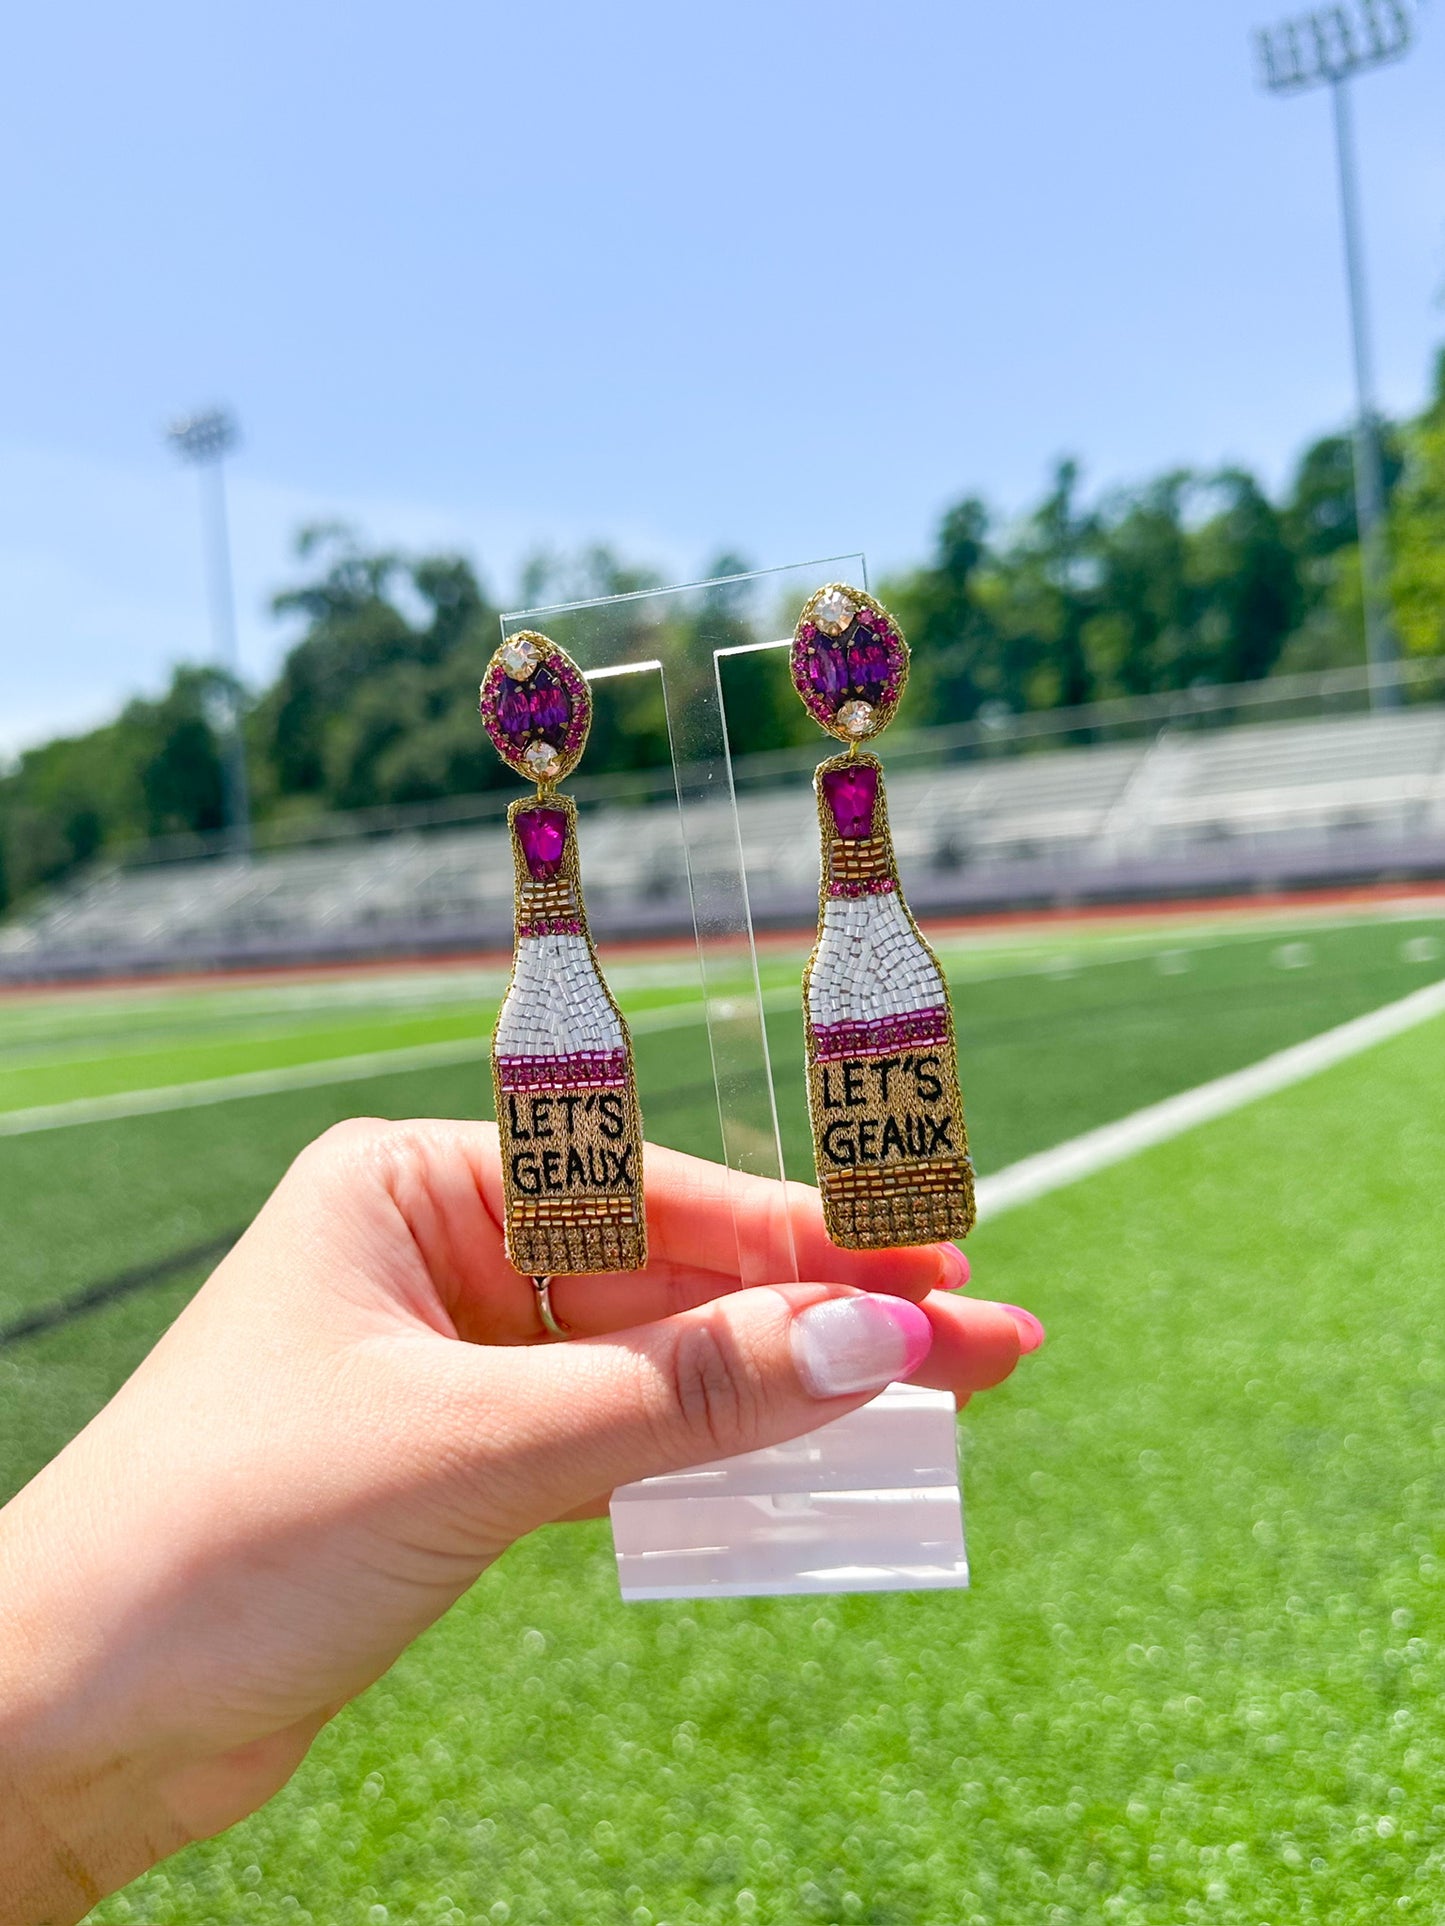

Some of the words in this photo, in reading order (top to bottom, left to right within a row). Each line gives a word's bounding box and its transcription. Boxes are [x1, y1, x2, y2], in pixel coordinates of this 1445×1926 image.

[823, 1054, 942, 1109] LET'S
[509, 1093, 624, 1140] LET'S
[822, 1114, 953, 1165] GEAUX
[512, 1143, 634, 1194] GEAUX
